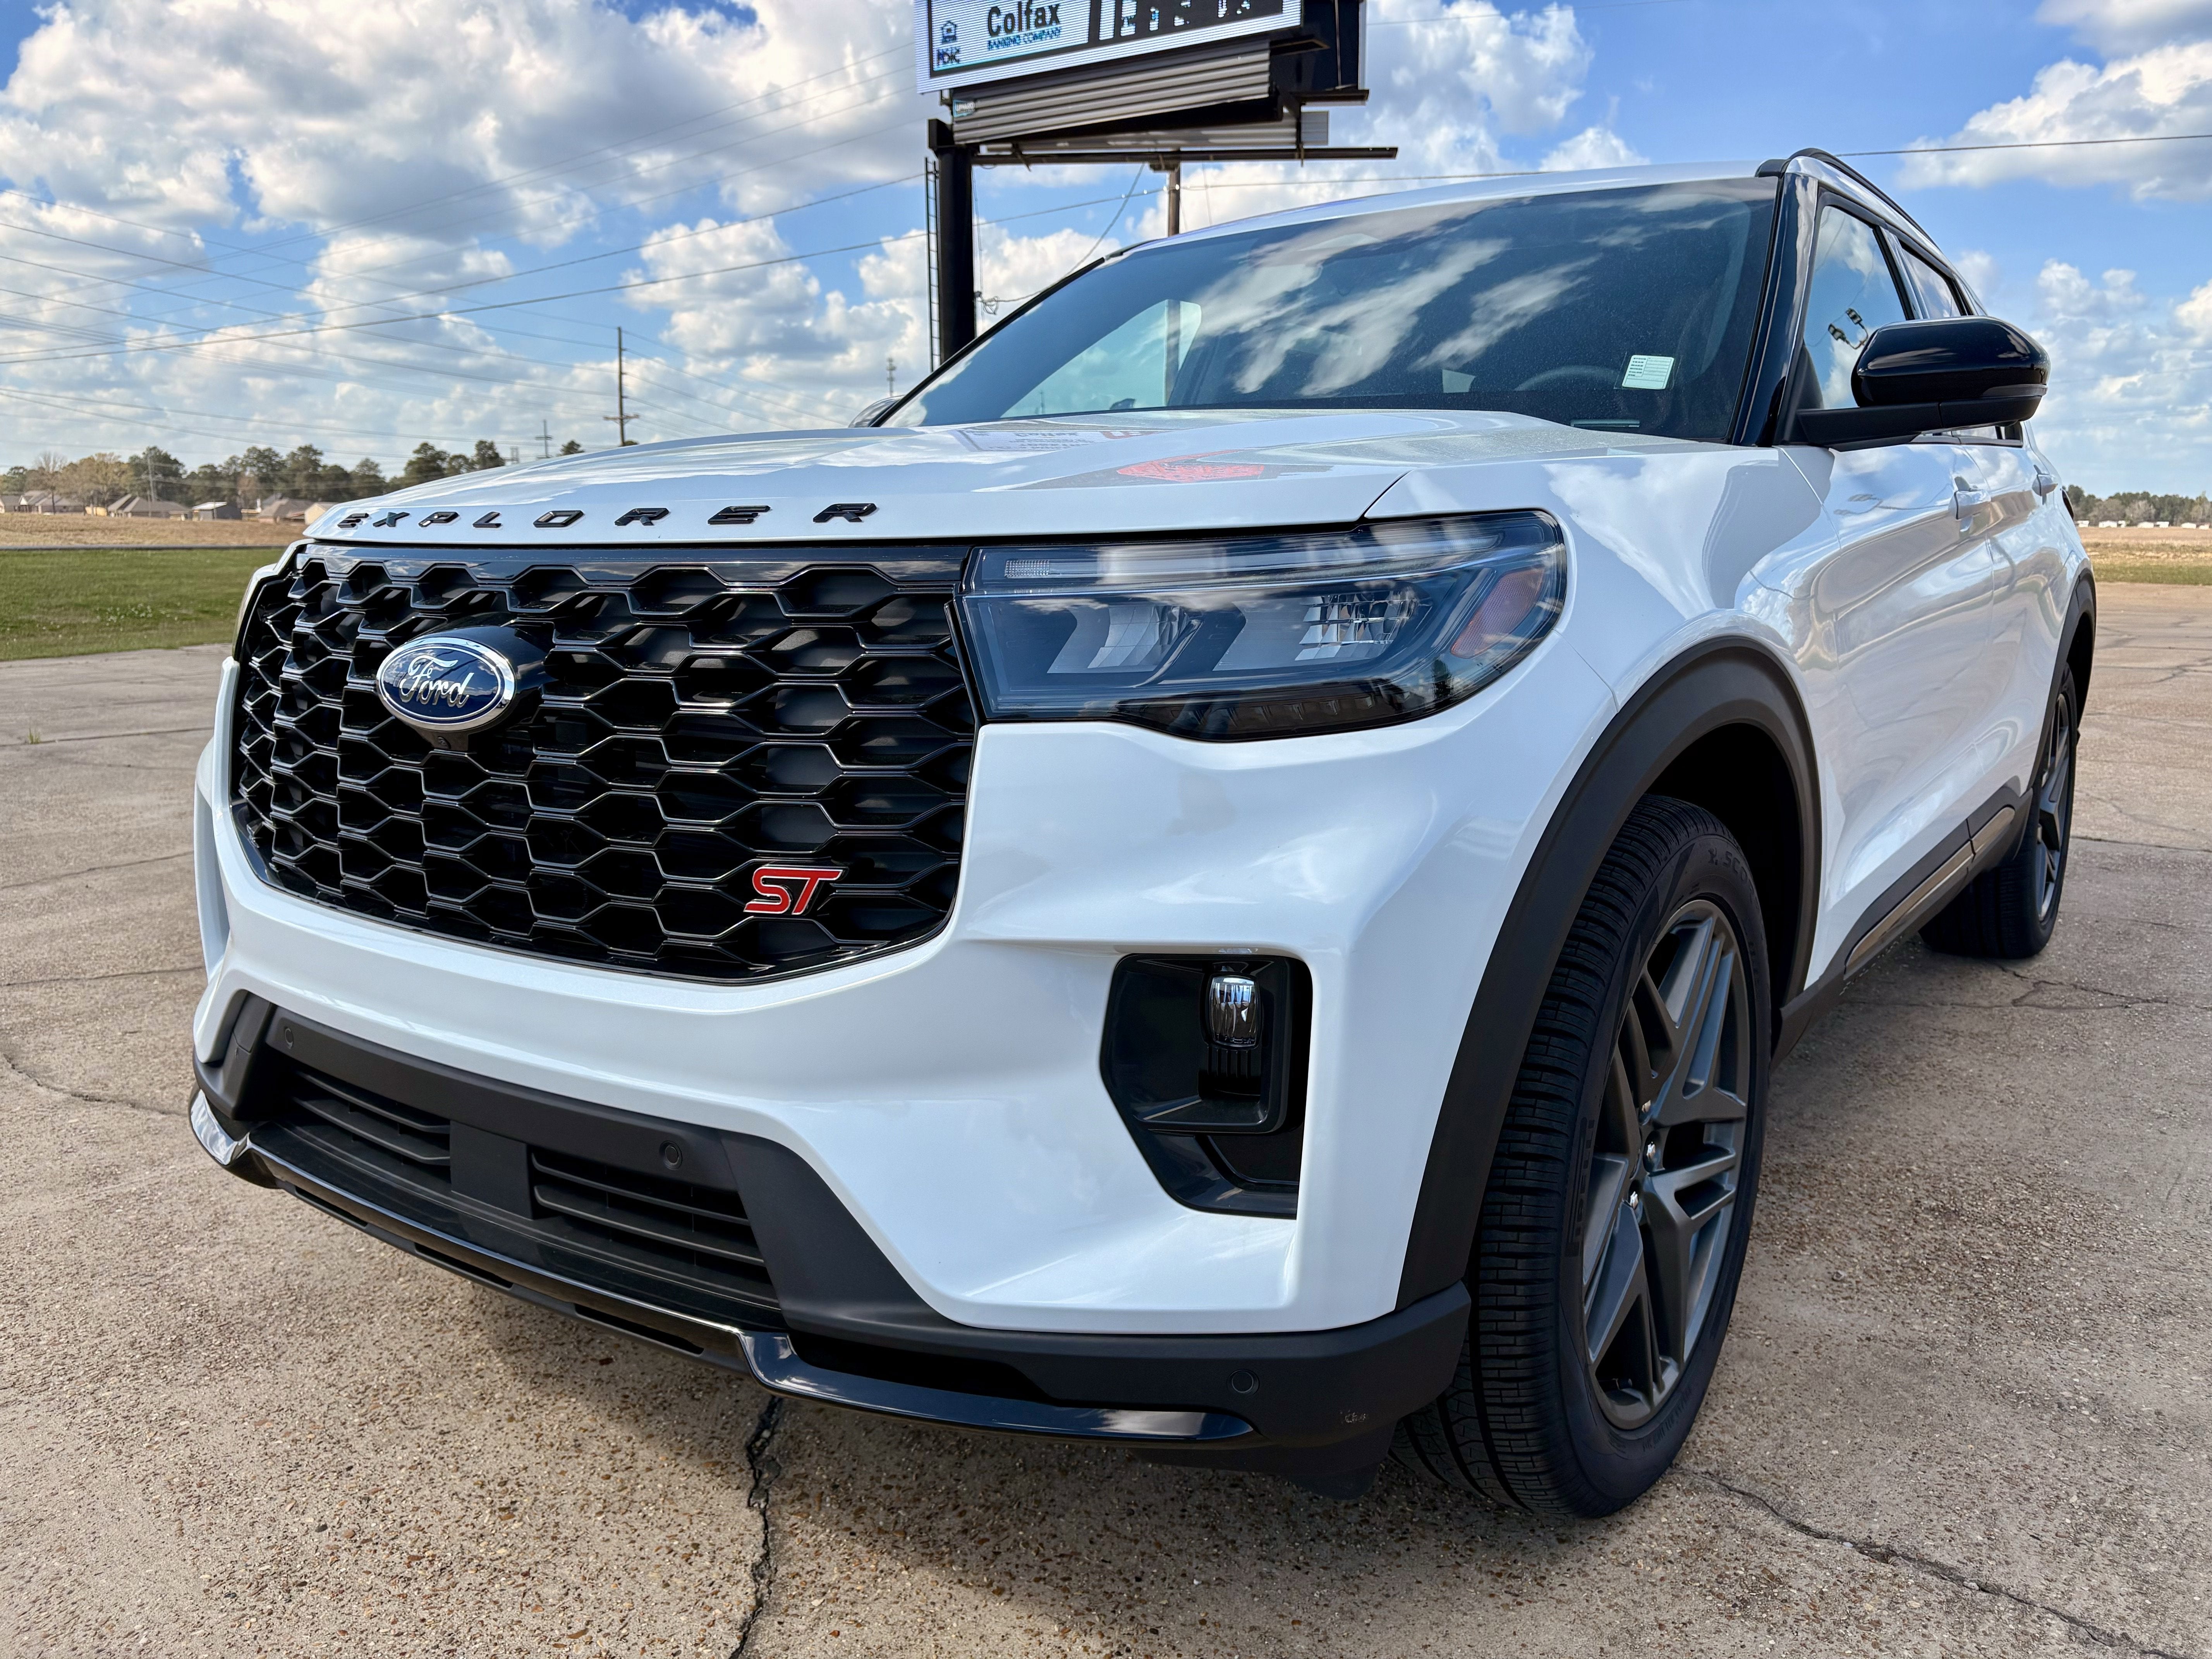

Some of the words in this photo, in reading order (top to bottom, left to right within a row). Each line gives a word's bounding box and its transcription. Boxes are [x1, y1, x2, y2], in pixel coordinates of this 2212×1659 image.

[988, 0, 1060, 36] Colfax
[337, 503, 877, 528] EXPLORER
[399, 654, 474, 707] Ford
[743, 866, 843, 915] ST
